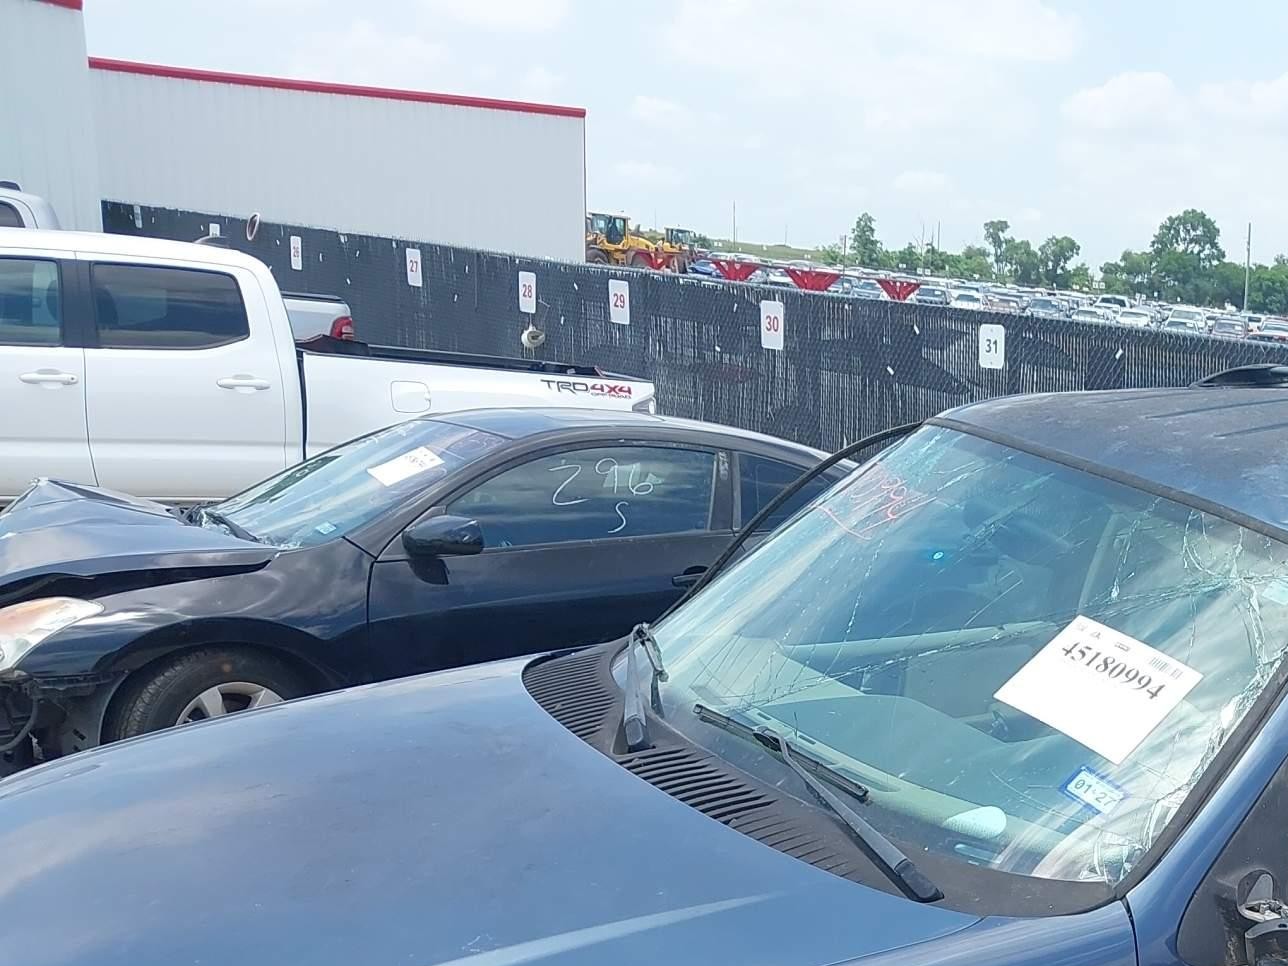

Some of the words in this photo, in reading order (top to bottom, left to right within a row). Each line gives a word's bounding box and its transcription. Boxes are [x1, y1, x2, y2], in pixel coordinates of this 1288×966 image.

[409, 260, 419, 273] 27
[522, 284, 533, 298] 28
[613, 292, 625, 309] 29
[765, 316, 779, 332] 30
[985, 339, 998, 354] 31
[540, 379, 589, 394] TRD
[548, 457, 653, 506] 296
[1062, 641, 1166, 700] 45180994
